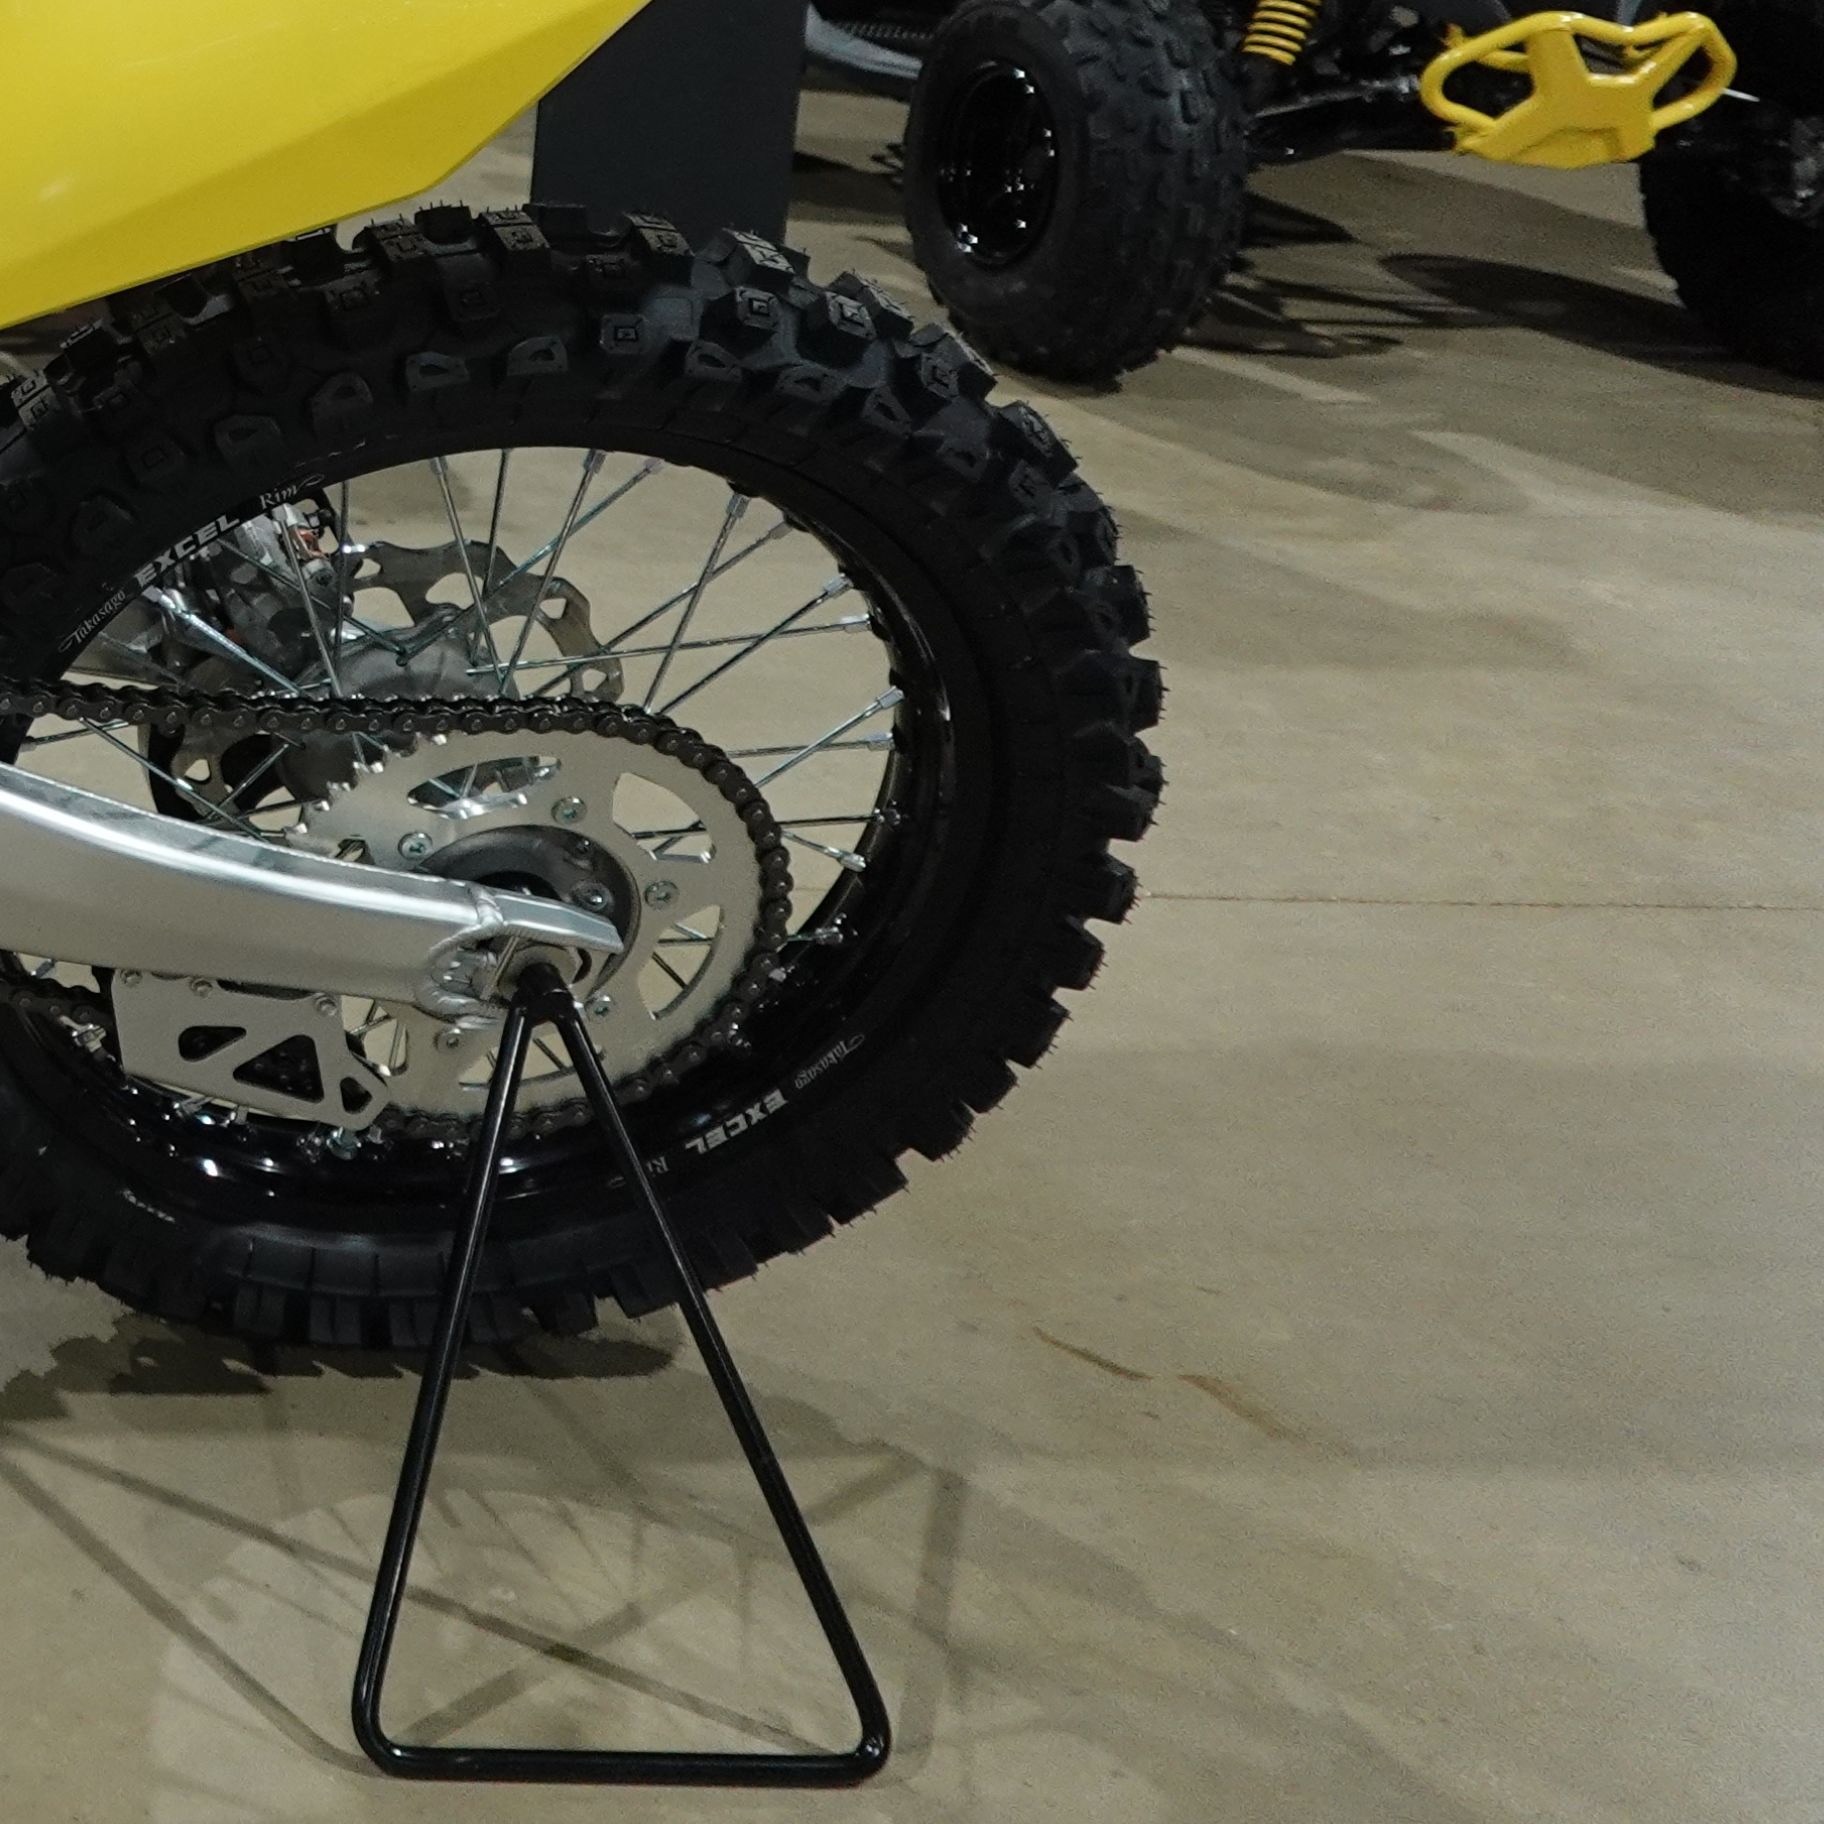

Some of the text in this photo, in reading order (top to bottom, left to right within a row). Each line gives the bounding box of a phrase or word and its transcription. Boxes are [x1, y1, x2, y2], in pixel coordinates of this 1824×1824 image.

[63, 484, 298, 649] Takasago EXCEL Rim
[684, 1088, 790, 1155] EXCEL
